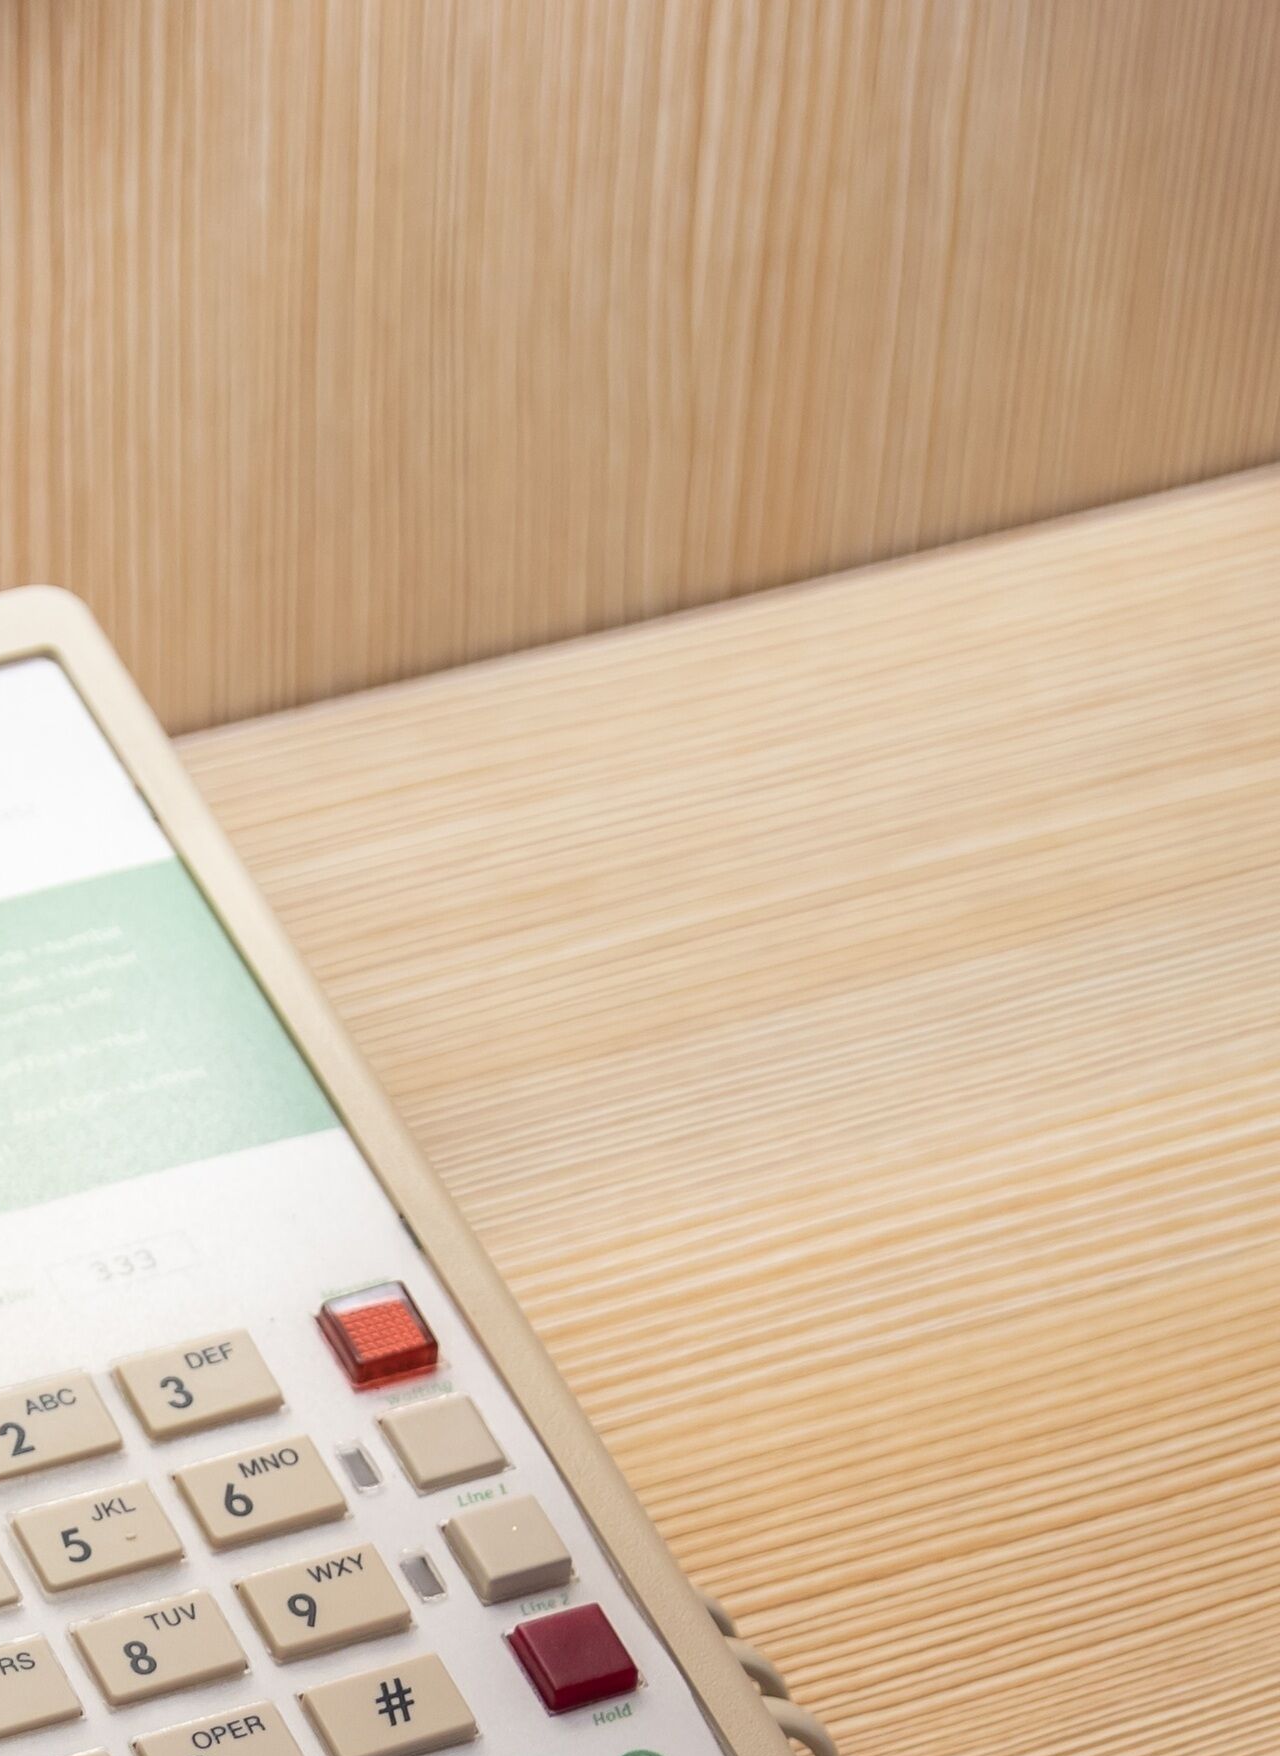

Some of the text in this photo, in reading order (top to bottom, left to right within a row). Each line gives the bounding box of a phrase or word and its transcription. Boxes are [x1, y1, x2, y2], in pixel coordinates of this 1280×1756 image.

[91, 1248, 158, 1282] 333
[183, 1341, 236, 1371] DEF
[24, 1387, 78, 1417] ABC
[159, 1374, 195, 1410] 3
[237, 1446, 301, 1480] MNO
[90, 1496, 137, 1524] JKL
[223, 1482, 255, 1518] 6
[456, 1487, 495, 1509] Line
[60, 1527, 93, 1564] 5
[307, 1552, 366, 1585] WXY
[144, 1602, 199, 1633] TUV
[286, 1592, 319, 1629] 9
[519, 1597, 558, 1617] Line
[122, 1640, 159, 1677] 8
[375, 1677, 416, 1728] #
[591, 1702, 634, 1727] Hold
[190, 1714, 268, 1752] OPER
